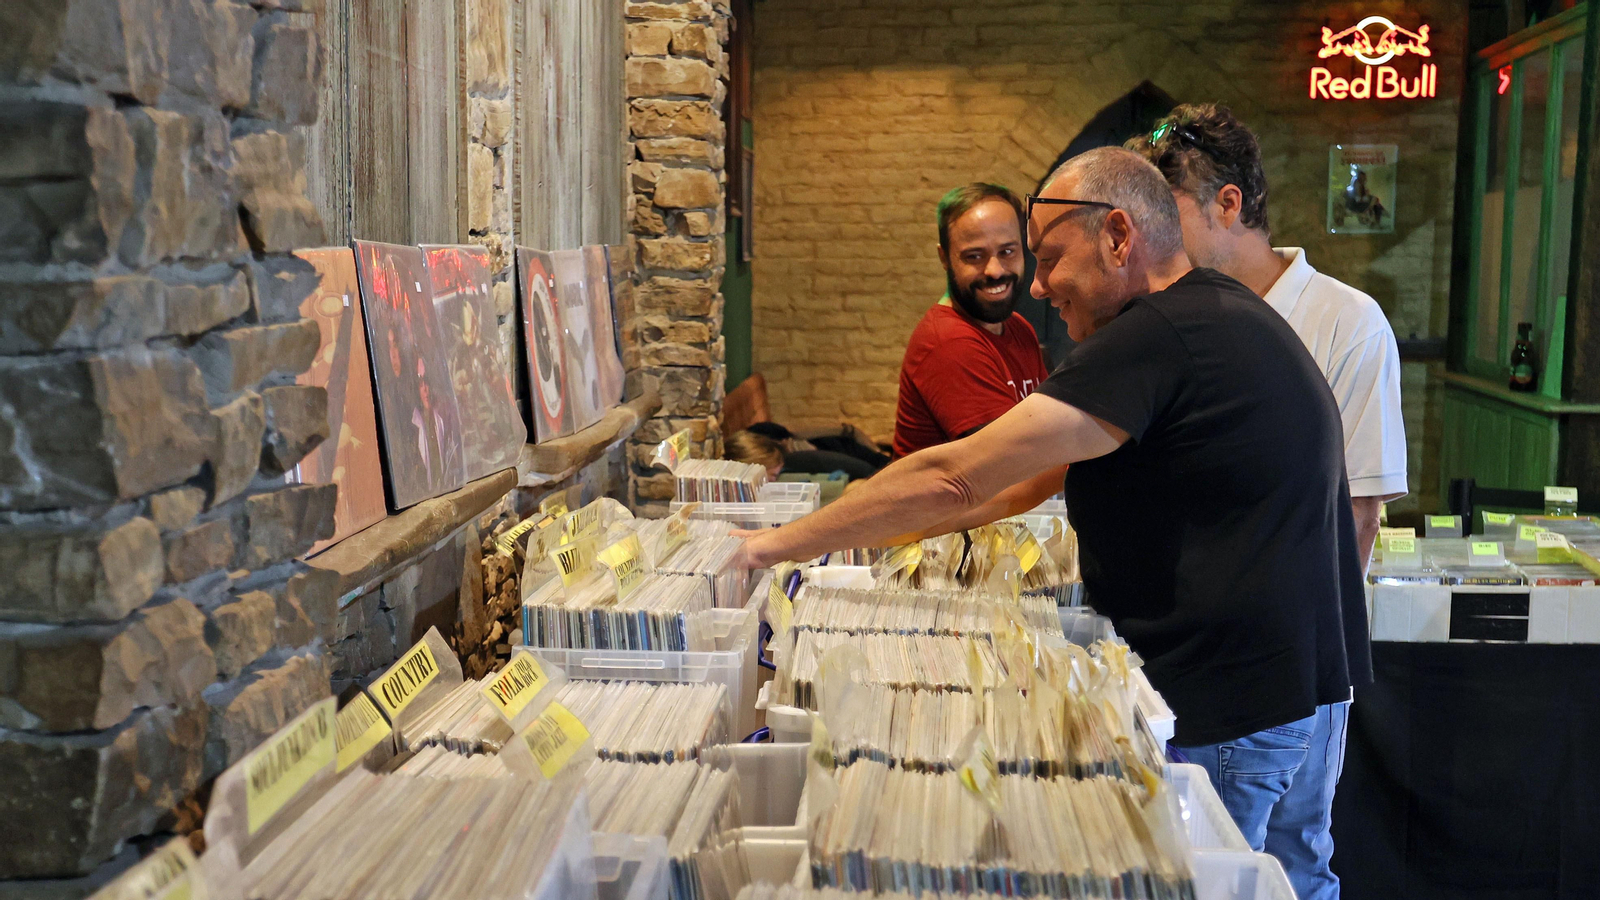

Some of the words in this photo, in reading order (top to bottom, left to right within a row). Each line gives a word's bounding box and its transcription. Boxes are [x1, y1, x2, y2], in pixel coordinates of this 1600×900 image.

[1309, 65, 1372, 99] Red
[1376, 63, 1437, 98] Bull
[382, 646, 434, 709] COUNTRY
